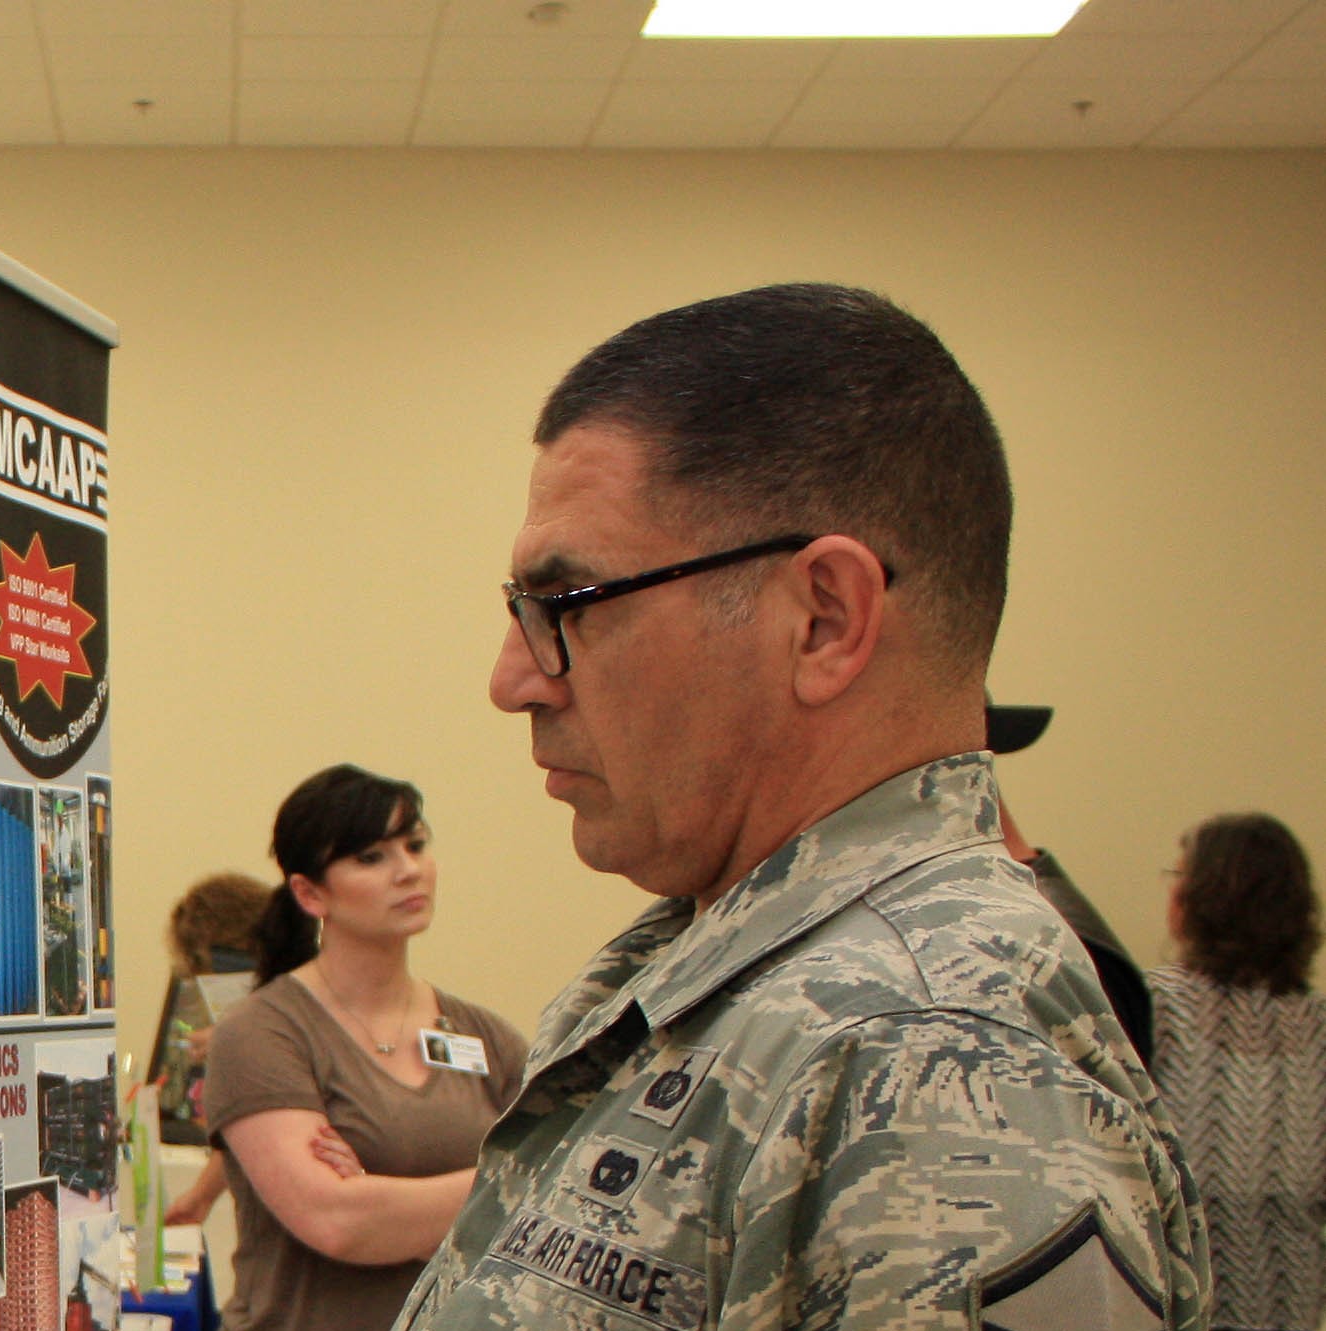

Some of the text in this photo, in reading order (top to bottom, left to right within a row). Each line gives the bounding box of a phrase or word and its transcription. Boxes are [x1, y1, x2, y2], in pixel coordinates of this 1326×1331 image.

[8, 574, 22, 593] ISO
[8, 604, 21, 622] ISO
[503, 1216, 673, 1315] U.S. AIR FORCE
